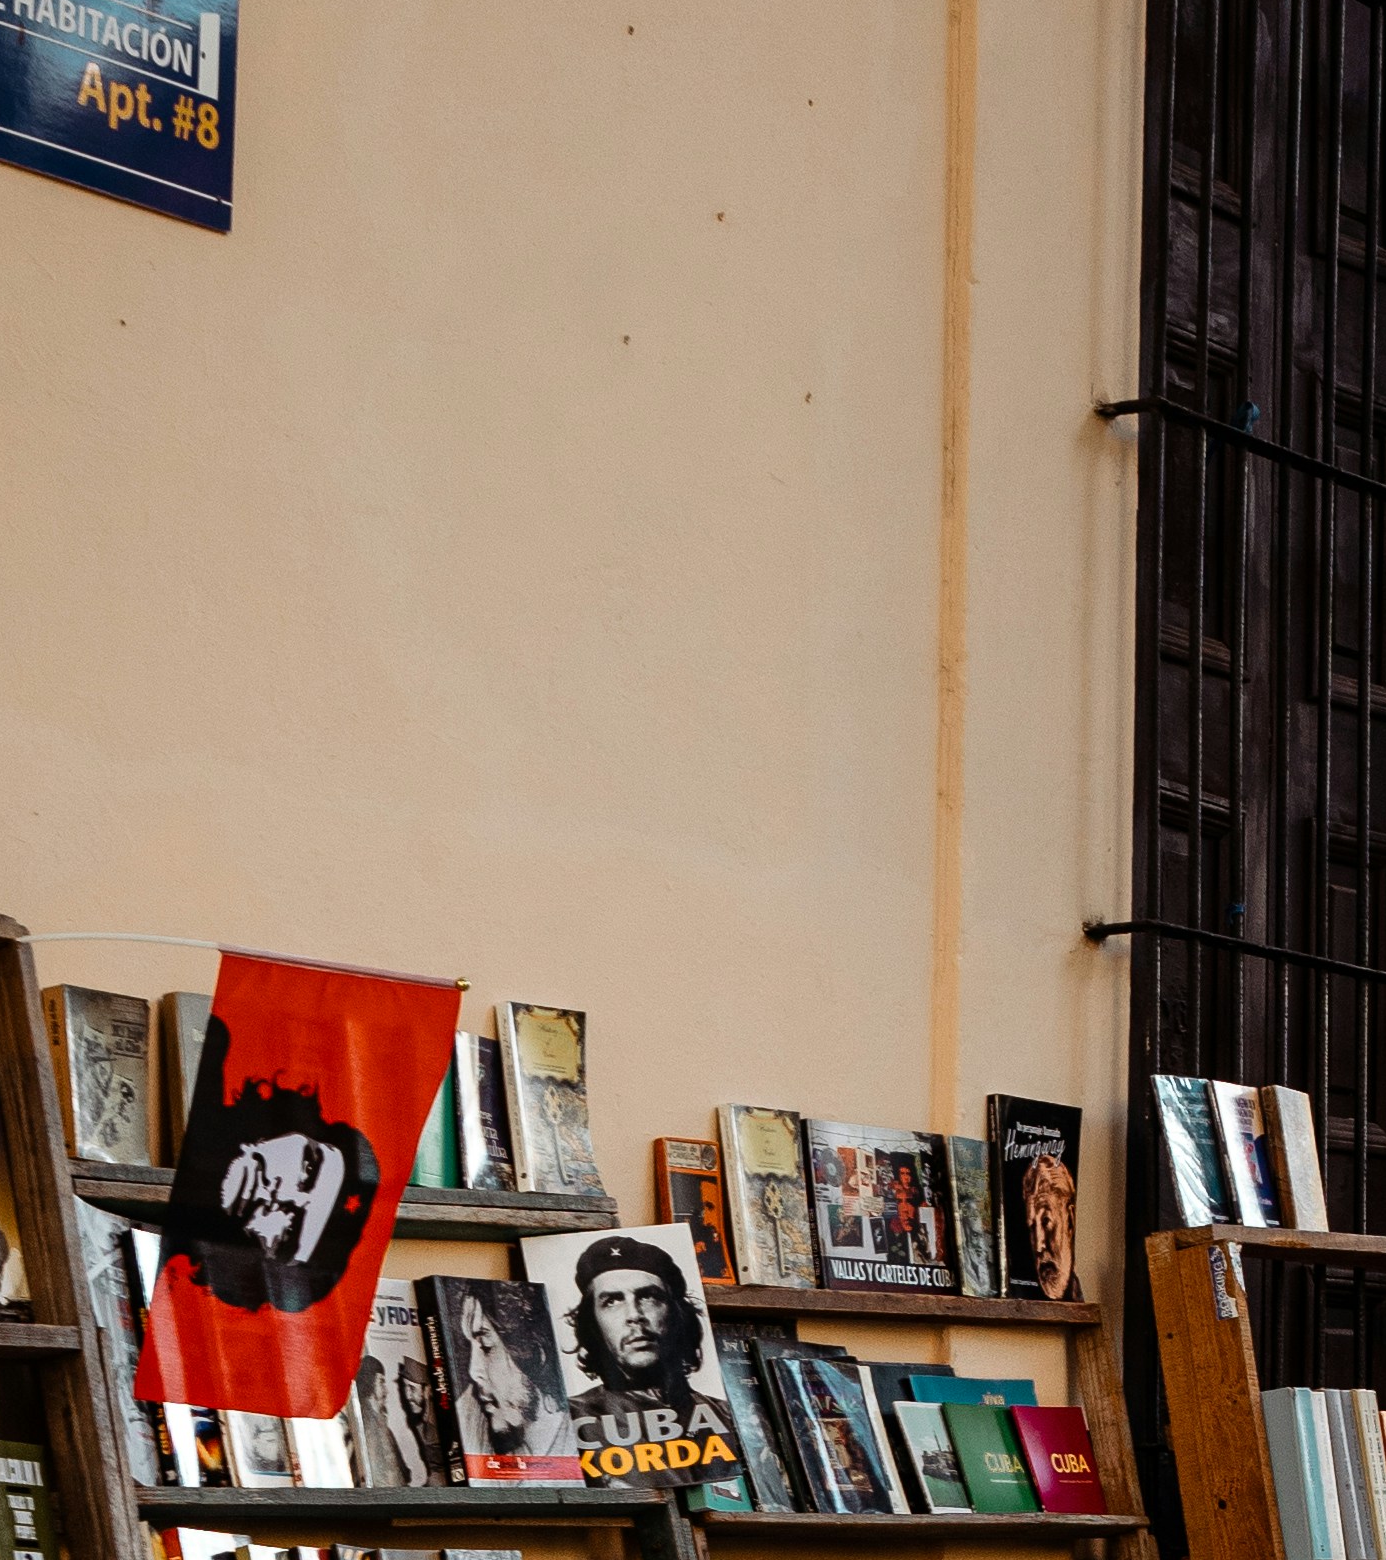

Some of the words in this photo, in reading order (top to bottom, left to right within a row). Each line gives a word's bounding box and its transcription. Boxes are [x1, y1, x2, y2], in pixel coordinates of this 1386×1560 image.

[78, 63, 162, 132] Apt.
[173, 102, 220, 151] #8
[1005, 1129, 1065, 1168] Hemingway
[830, 1260, 865, 1281] VALLAS
[866, 1262, 874, 1281] Y
[875, 1263, 918, 1285] CARTELES
[919, 1267, 932, 1285] DE
[575, 1403, 729, 1449] CUBA
[579, 1435, 737, 1478] KORDA
[983, 1451, 1024, 1474] CUBA
[1050, 1452, 1090, 1474] CUBA
